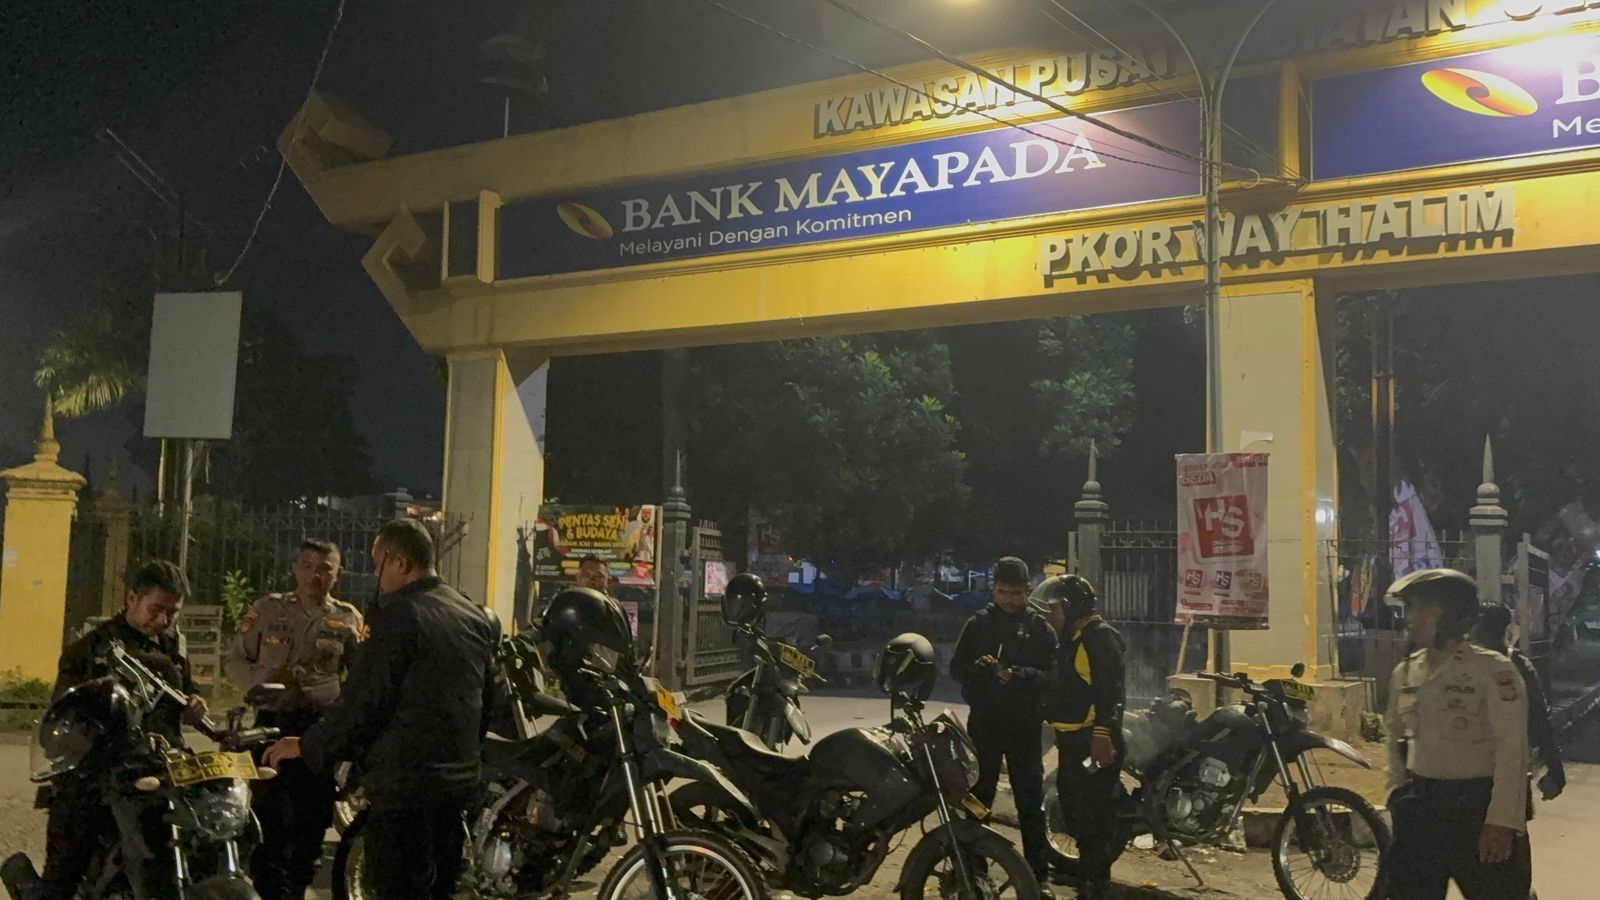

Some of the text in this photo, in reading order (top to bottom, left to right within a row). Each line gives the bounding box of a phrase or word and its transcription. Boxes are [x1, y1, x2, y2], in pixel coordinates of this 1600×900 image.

[815, 65, 1016, 138] KAWASAN
[621, 132, 1107, 233] BANK MAYAPADA
[619, 208, 912, 258] Melayani Dengan Komitmen
[1039, 185, 1515, 277] PKOR WAY HALIM
[558, 513, 601, 529] PENTAS
[575, 526, 618, 541] BUDAYA
